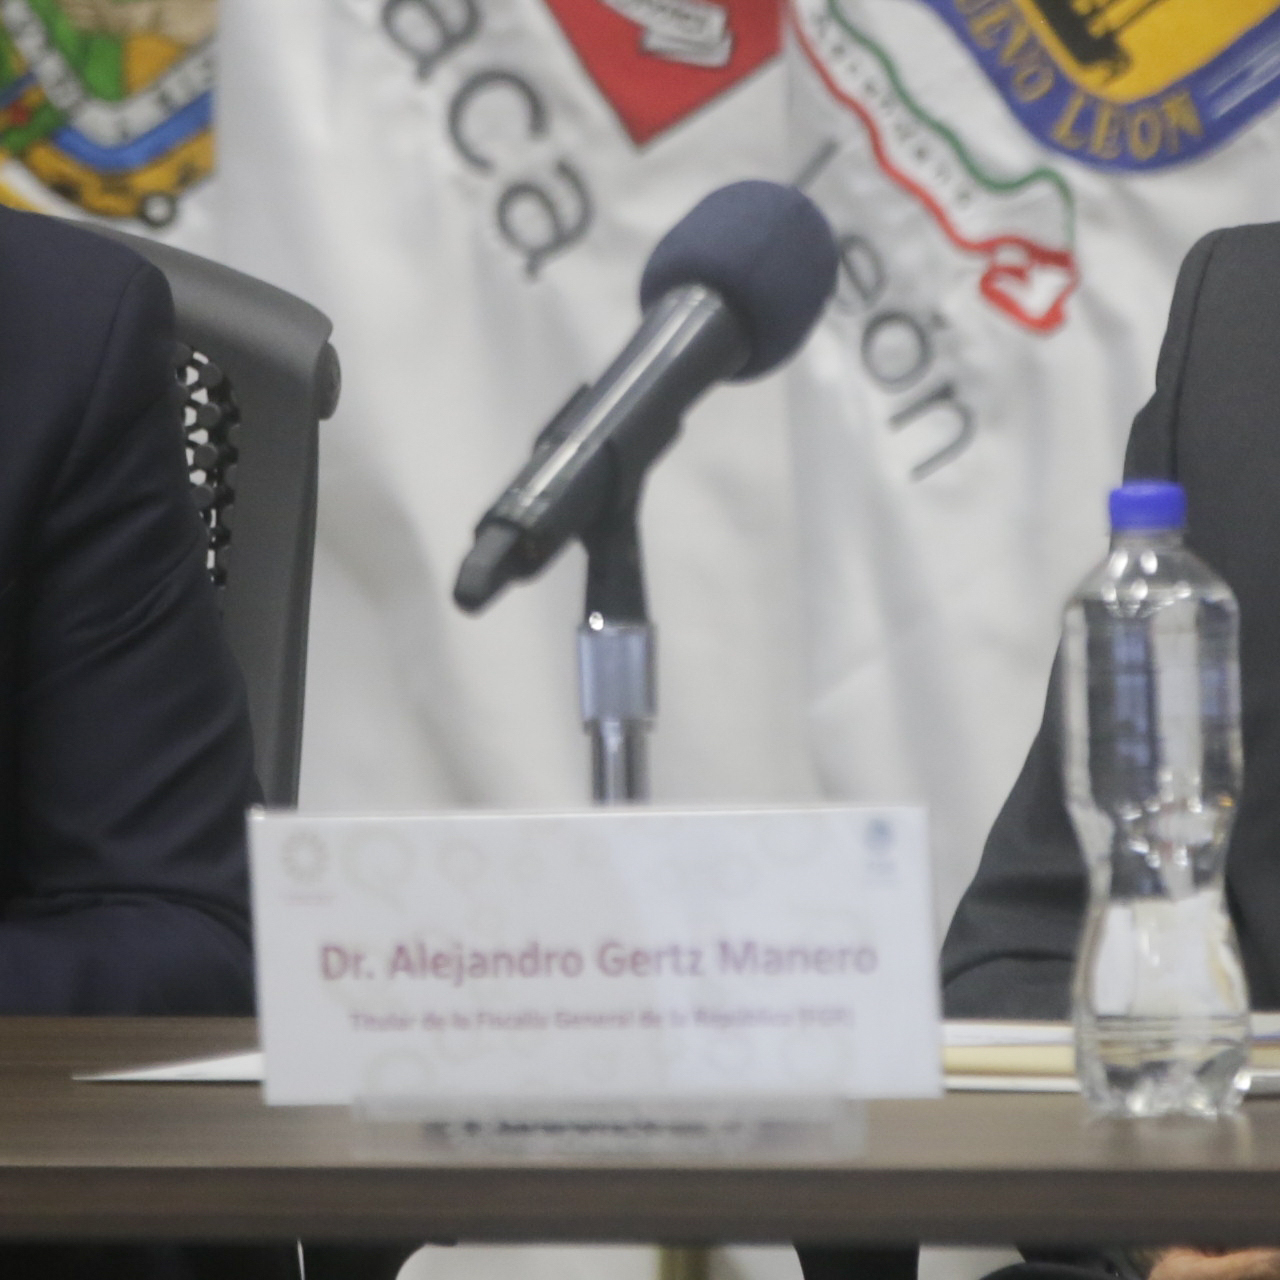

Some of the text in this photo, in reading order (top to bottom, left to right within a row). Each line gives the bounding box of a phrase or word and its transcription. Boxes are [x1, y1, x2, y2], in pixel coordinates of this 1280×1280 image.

[320, 939, 878, 987] Dr. Alejandro Gertz Manero
